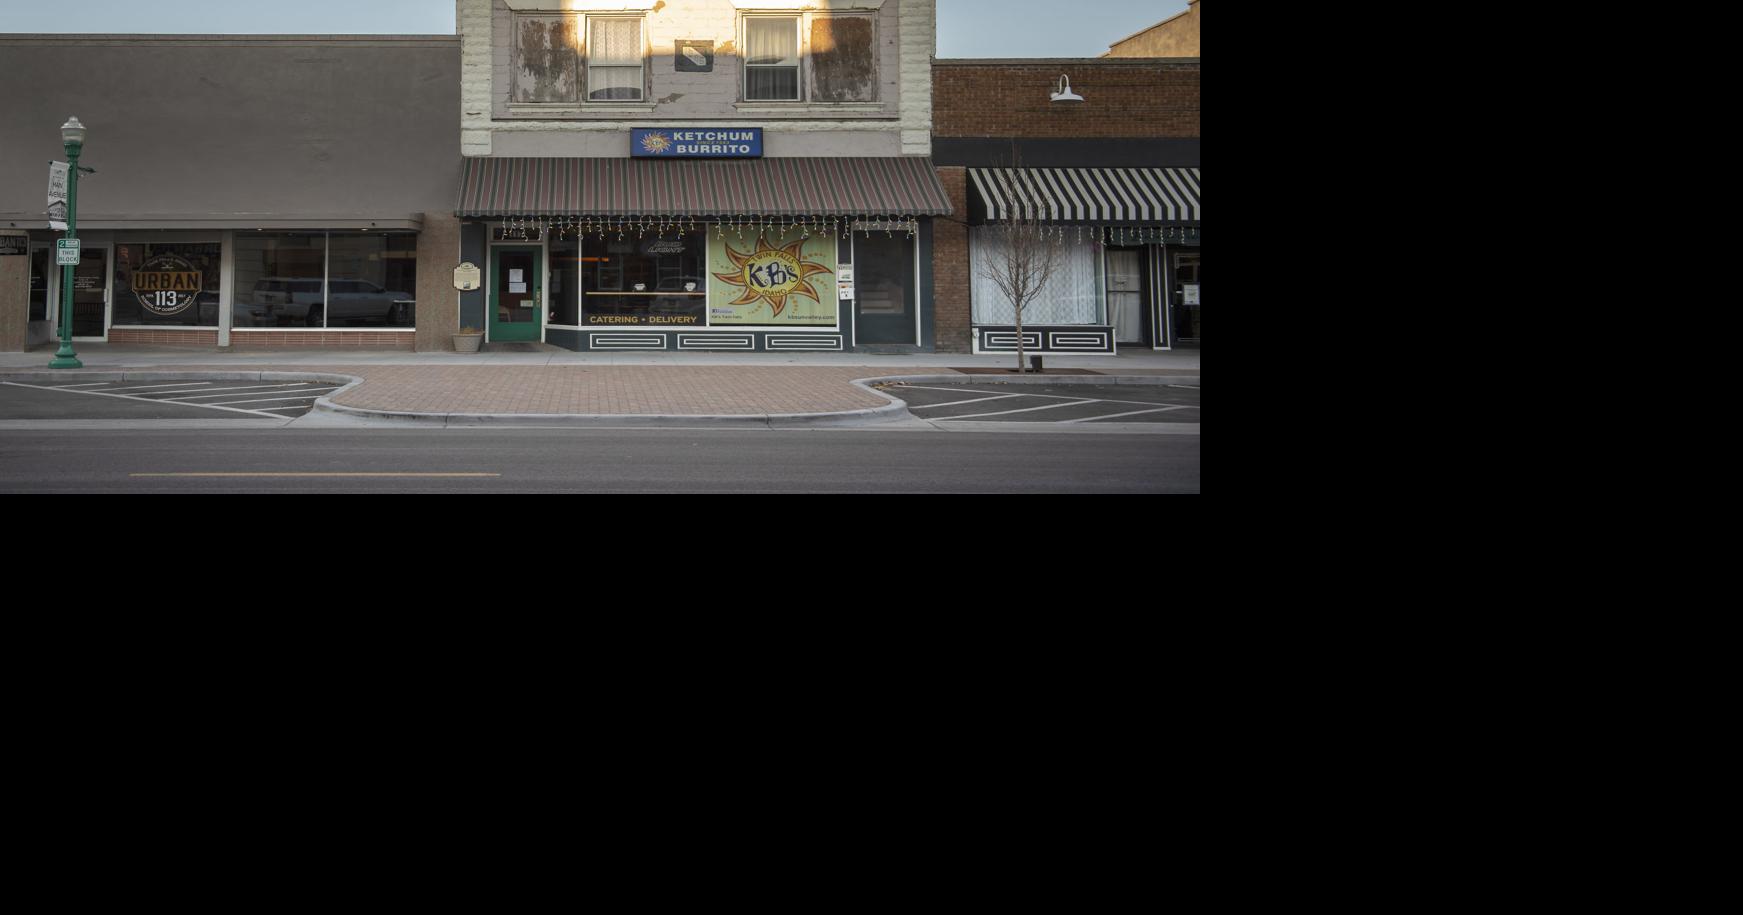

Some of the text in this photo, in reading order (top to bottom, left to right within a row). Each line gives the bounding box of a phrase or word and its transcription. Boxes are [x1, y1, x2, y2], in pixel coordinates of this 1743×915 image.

[673, 132, 753, 141] KETCHUM
[677, 145, 750, 154] BURRITO
[59, 240, 65, 248] 2
[750, 252, 796, 265] TWIN FALLS
[135, 273, 199, 289] URBAN
[762, 288, 787, 296] IDAHO
[154, 290, 177, 306] 113
